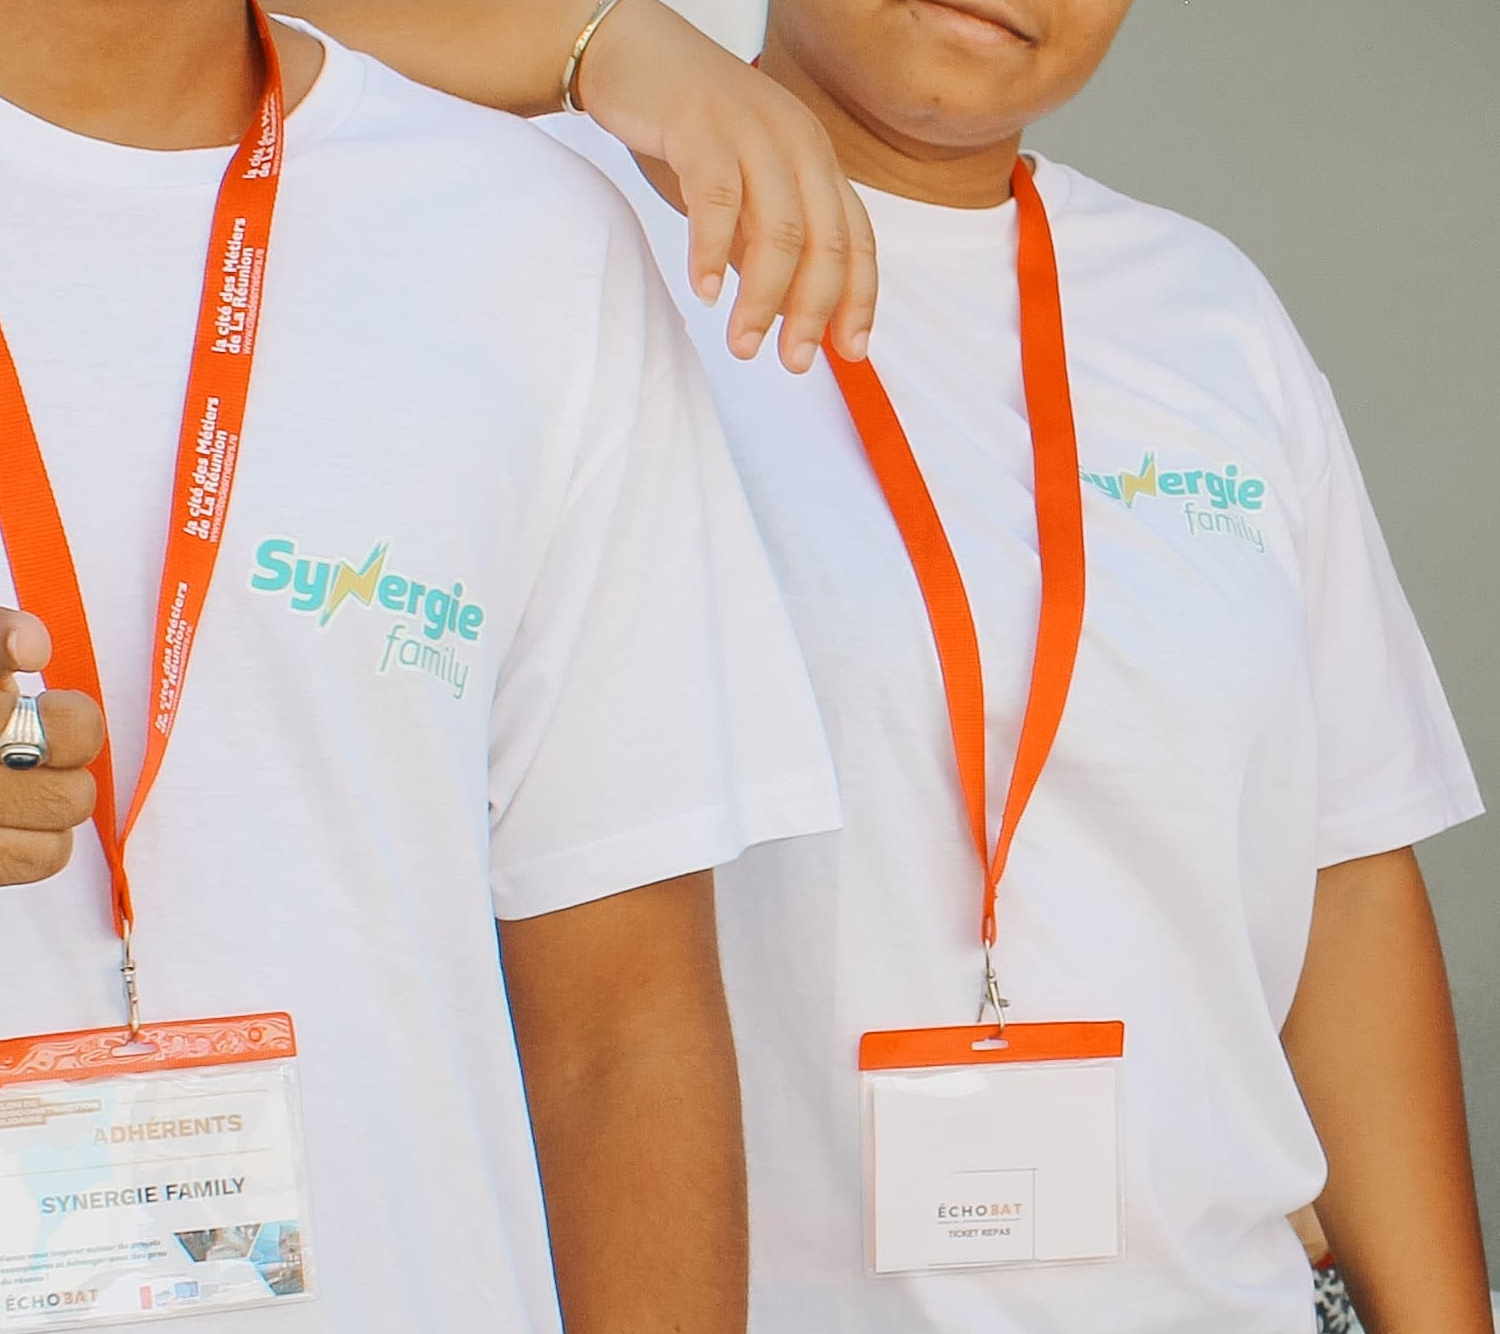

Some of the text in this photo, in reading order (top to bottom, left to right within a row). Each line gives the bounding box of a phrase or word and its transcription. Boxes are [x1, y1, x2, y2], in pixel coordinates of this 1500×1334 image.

[211, 217, 247, 353] la cité des Métiers
[227, 247, 255, 354] de La Réunion
[183, 396, 220, 536] la cité des Métiers
[196, 429, 228, 541] de La Réunion
[1184, 502, 1265, 554] family
[165, 581, 189, 645] Métiers
[379, 625, 469, 699] family
[92, 1114, 244, 1146] ADHÉRENTS
[41, 1177, 246, 1215] SYNERGIE FAMILY
[938, 1203, 1022, 1218] ÉCHOBAT
[6, 1288, 98, 1312] ÉCHOBAT
